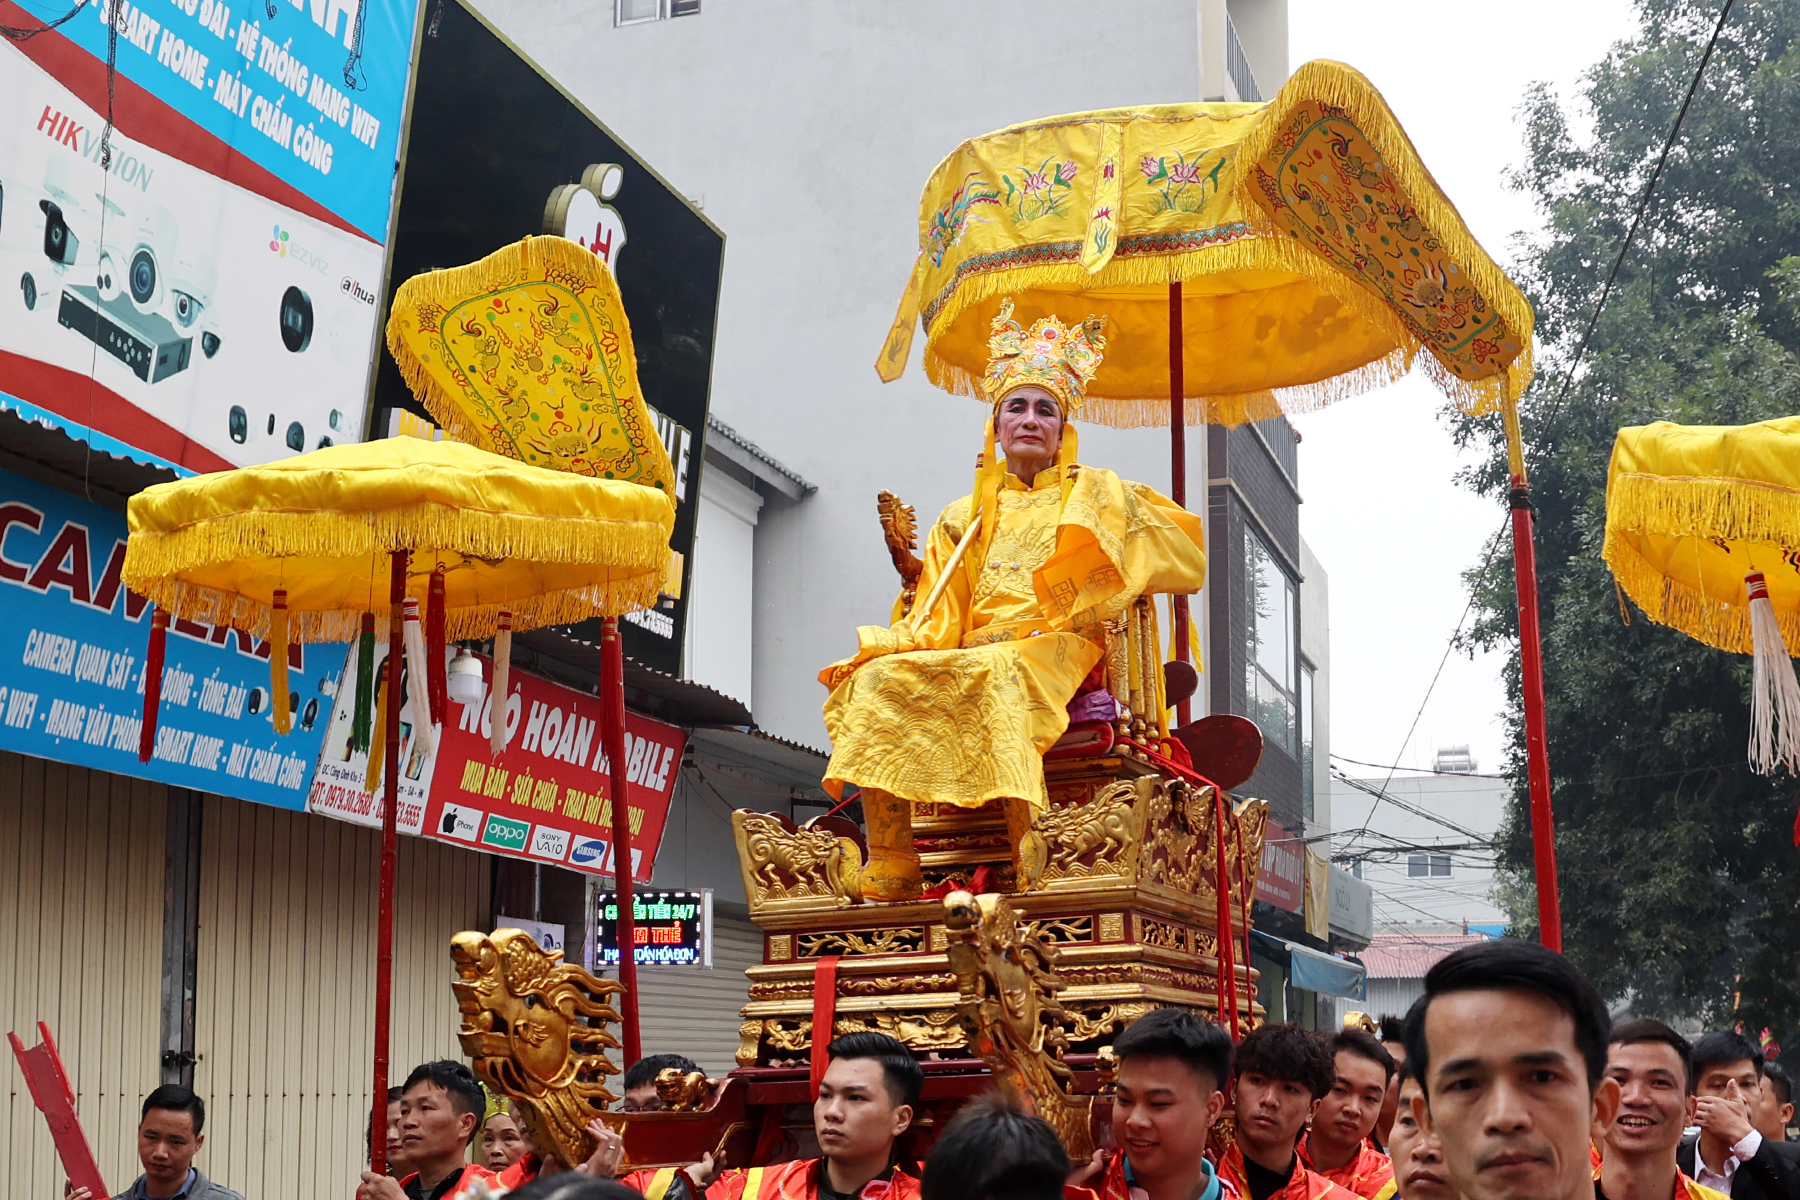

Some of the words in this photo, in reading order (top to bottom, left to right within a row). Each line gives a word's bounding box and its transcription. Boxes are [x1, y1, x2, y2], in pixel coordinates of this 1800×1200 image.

[235, 19, 260, 70] HỆ
[257, 37, 309, 97] THỐNG
[307, 73, 350, 128] MẠNG
[350, 103, 381, 149] WIFI
[157, 28, 209, 90] HOME
[213, 69, 252, 119] MÁY
[251, 93, 294, 150] CHẤM
[293, 122, 334, 175] CÔNG
[22, 628, 77, 675] CAMERA
[74, 643, 111, 685] QUAN
[106, 648, 135, 691] SÁT
[197, 666, 229, 715] TỔNG
[224, 680, 247, 720] ĐÀI
[5, 688, 39, 729] WIFI
[45, 698, 86, 744] MẠNG
[83, 703, 112, 746] VĂN
[107, 709, 144, 754] PHÒN
[153, 725, 194, 764] SMART
[189, 733, 224, 771] HOME
[225, 739, 254, 778] MÁY
[249, 741, 282, 784] CHẤM
[277, 751, 306, 790] CÔNG
[521, 702, 596, 768] HOÀN
[459, 759, 486, 791] MUA
[483, 763, 510, 800] BÁN
[510, 766, 534, 806] SỬA
[531, 778, 559, 813] CHỮA
[562, 787, 587, 820] TRAO
[583, 786, 604, 826] ĐỔI
[456, 819, 474, 831] iPhone
[488, 822, 525, 841] oppo
[536, 840, 563, 855] VAIO
[541, 832, 562, 842] SONY
[576, 845, 601, 858] SAMSUNG
[671, 904, 695, 920] 24/7
[651, 920, 682, 943] THẺ
